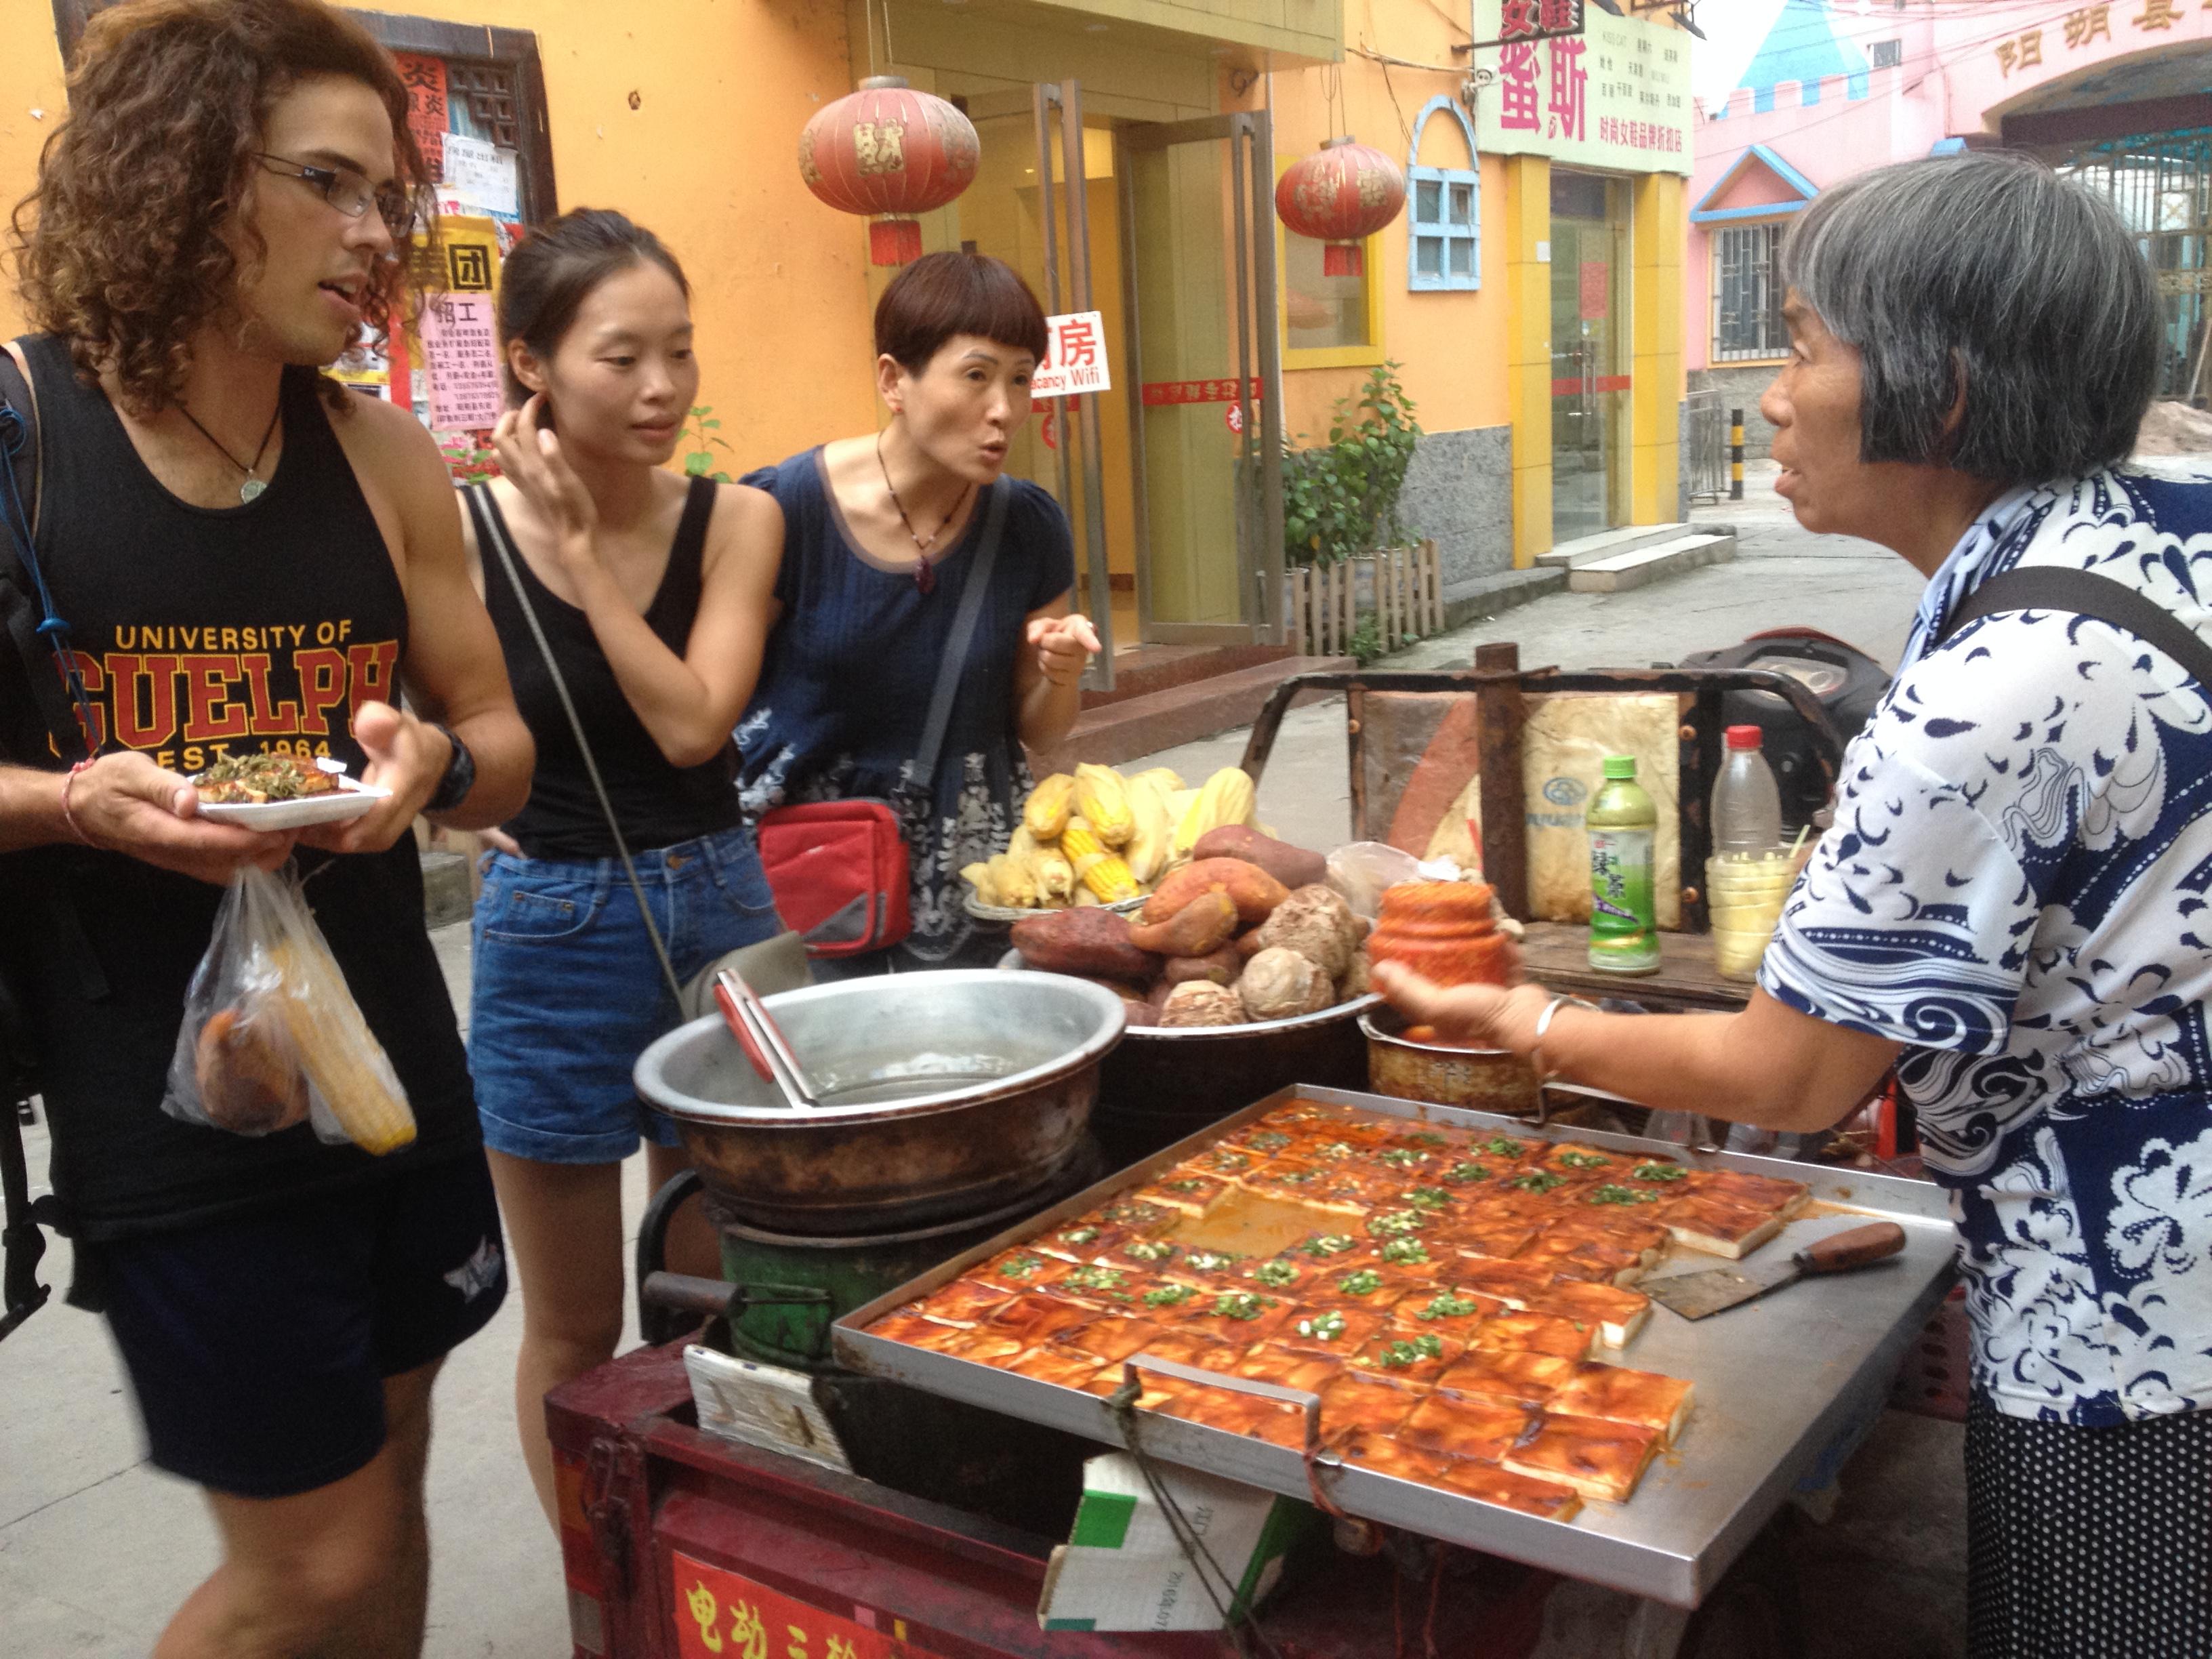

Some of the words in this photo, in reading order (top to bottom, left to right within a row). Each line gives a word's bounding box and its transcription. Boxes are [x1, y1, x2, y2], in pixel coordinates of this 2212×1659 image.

[1994, 0, 2212, 78] 阳朔县
[1600, 116, 1681, 152] 时尚女鞋品牌折扣店
[1029, 374, 1067, 391] acancy
[1071, 367, 1100, 387] Wifi
[115, 624, 306, 651] UNIVERSITY
[316, 619, 352, 645] OF
[50, 638, 398, 758] GUELPH
[260, 739, 331, 760] 1964
